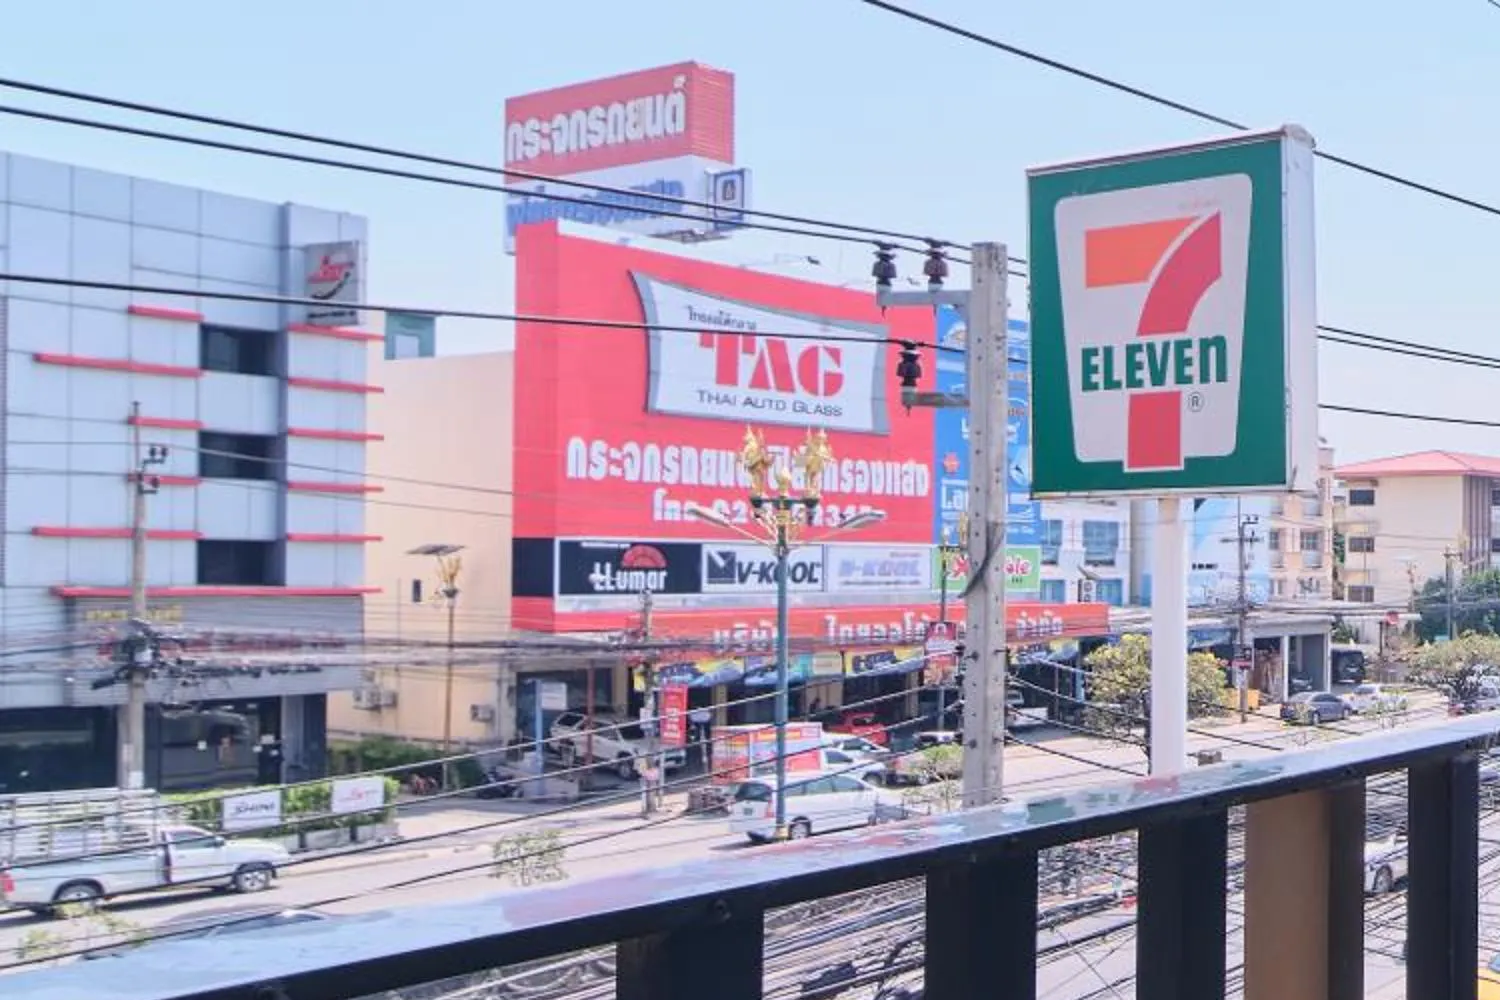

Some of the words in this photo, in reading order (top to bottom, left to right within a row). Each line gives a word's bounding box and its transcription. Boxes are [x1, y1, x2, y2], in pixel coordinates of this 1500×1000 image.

[506, 75, 687, 161] กระจกรถยนต์
[698, 390, 737, 405] THAI
[742, 395, 787, 412] AUTO
[792, 399, 843, 417] GLASS
[567, 436, 752, 488] กระจกรถยน
